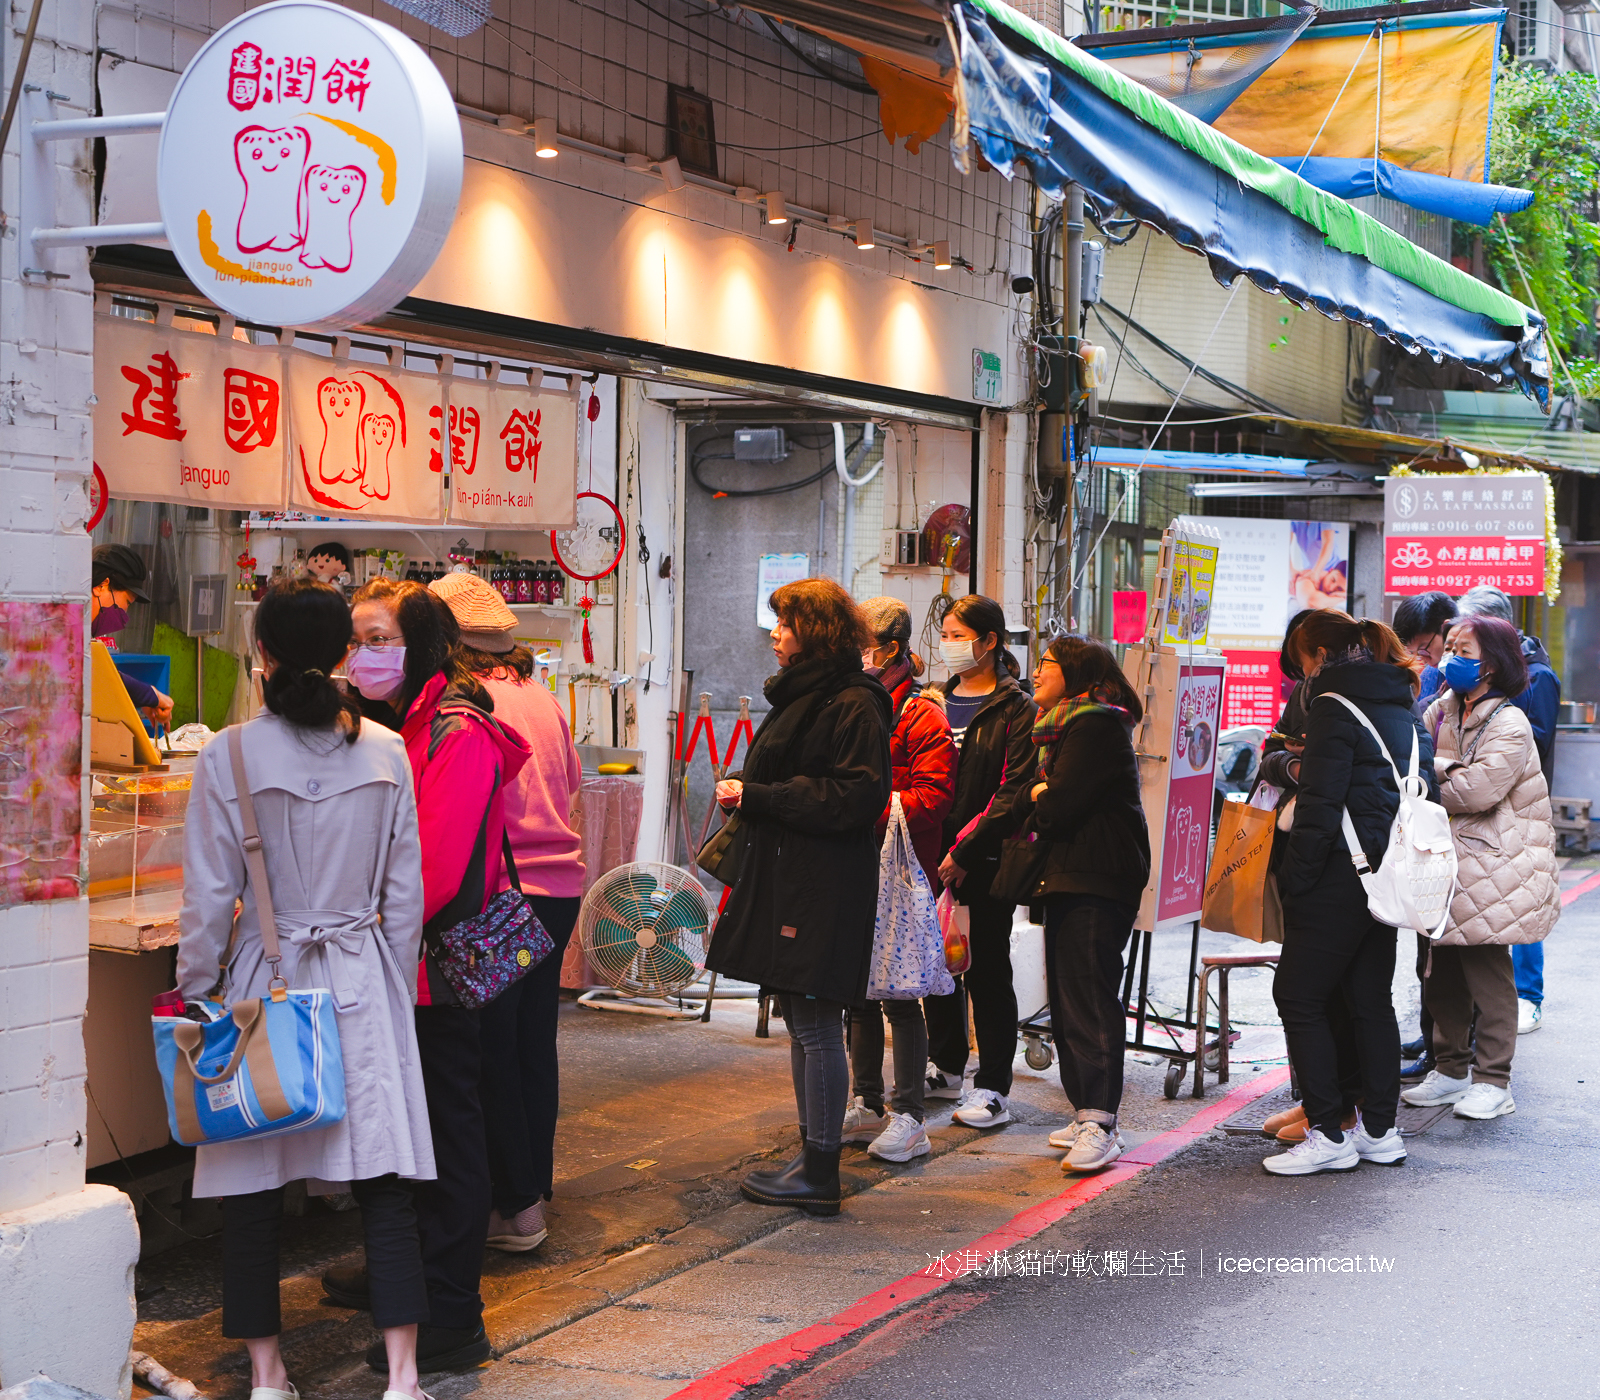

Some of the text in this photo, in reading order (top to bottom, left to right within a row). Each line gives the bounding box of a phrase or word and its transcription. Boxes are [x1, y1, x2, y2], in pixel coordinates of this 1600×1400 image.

[248, 259, 293, 273] jianguo
[986, 378, 996, 399] 11
[1473, 502, 1533, 511] MASSAGE
[1437, 545, 1534, 561] 小芳越南美甲
